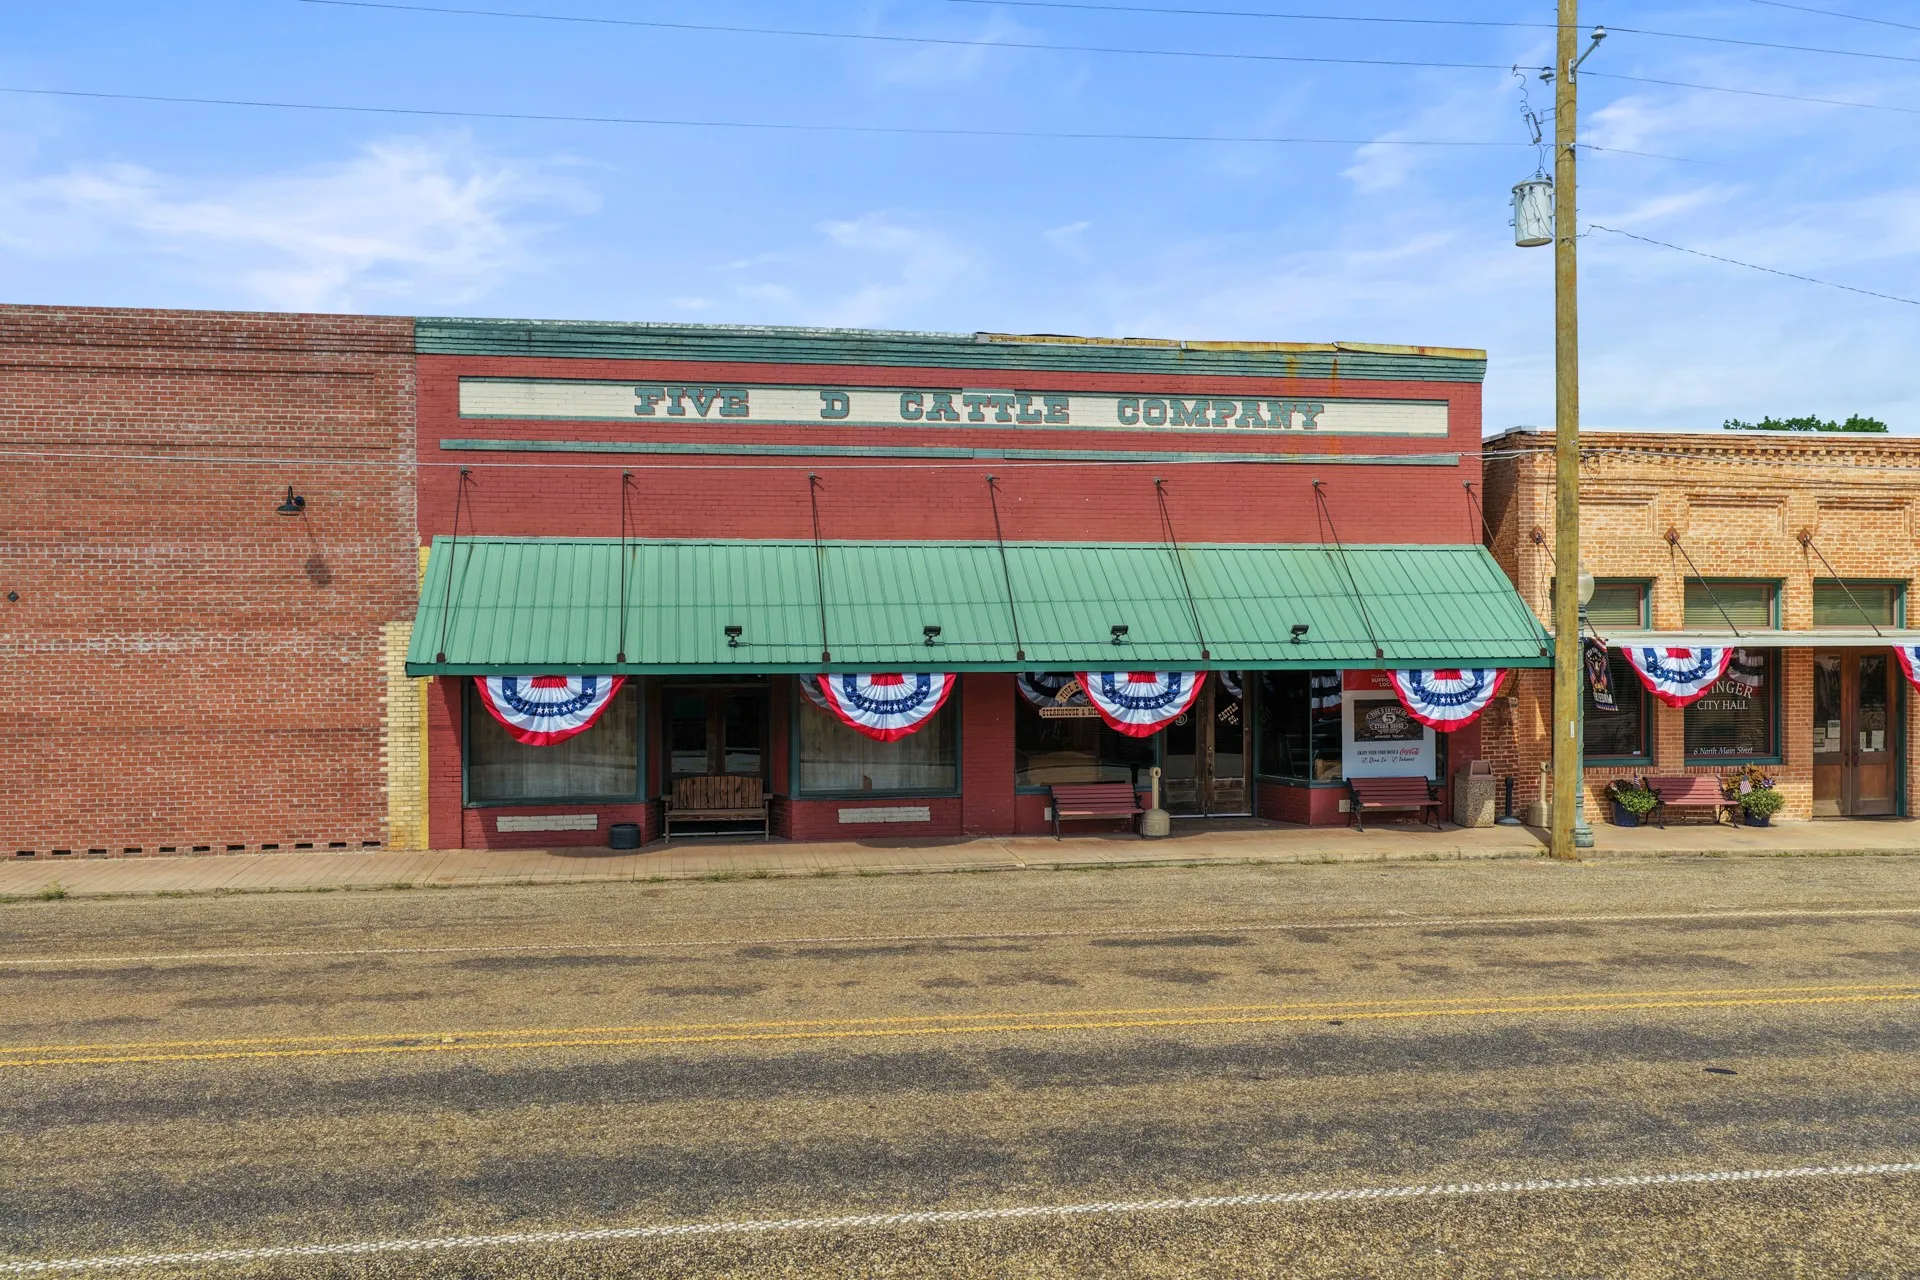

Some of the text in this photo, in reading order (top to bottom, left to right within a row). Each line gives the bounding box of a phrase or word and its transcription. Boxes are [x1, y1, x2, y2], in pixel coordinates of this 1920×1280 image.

[635, 387, 1323, 430] FIVE D CATTLE COMPANY
[1060, 685, 1074, 699] FIVE
[1711, 681, 1753, 699] INGER
[1042, 708, 1079, 716] STEAKHOUSE
[1218, 702, 1239, 721] CATTLE
[1697, 700, 1748, 710] CITY HALL
[1228, 715, 1239, 725] CO.
